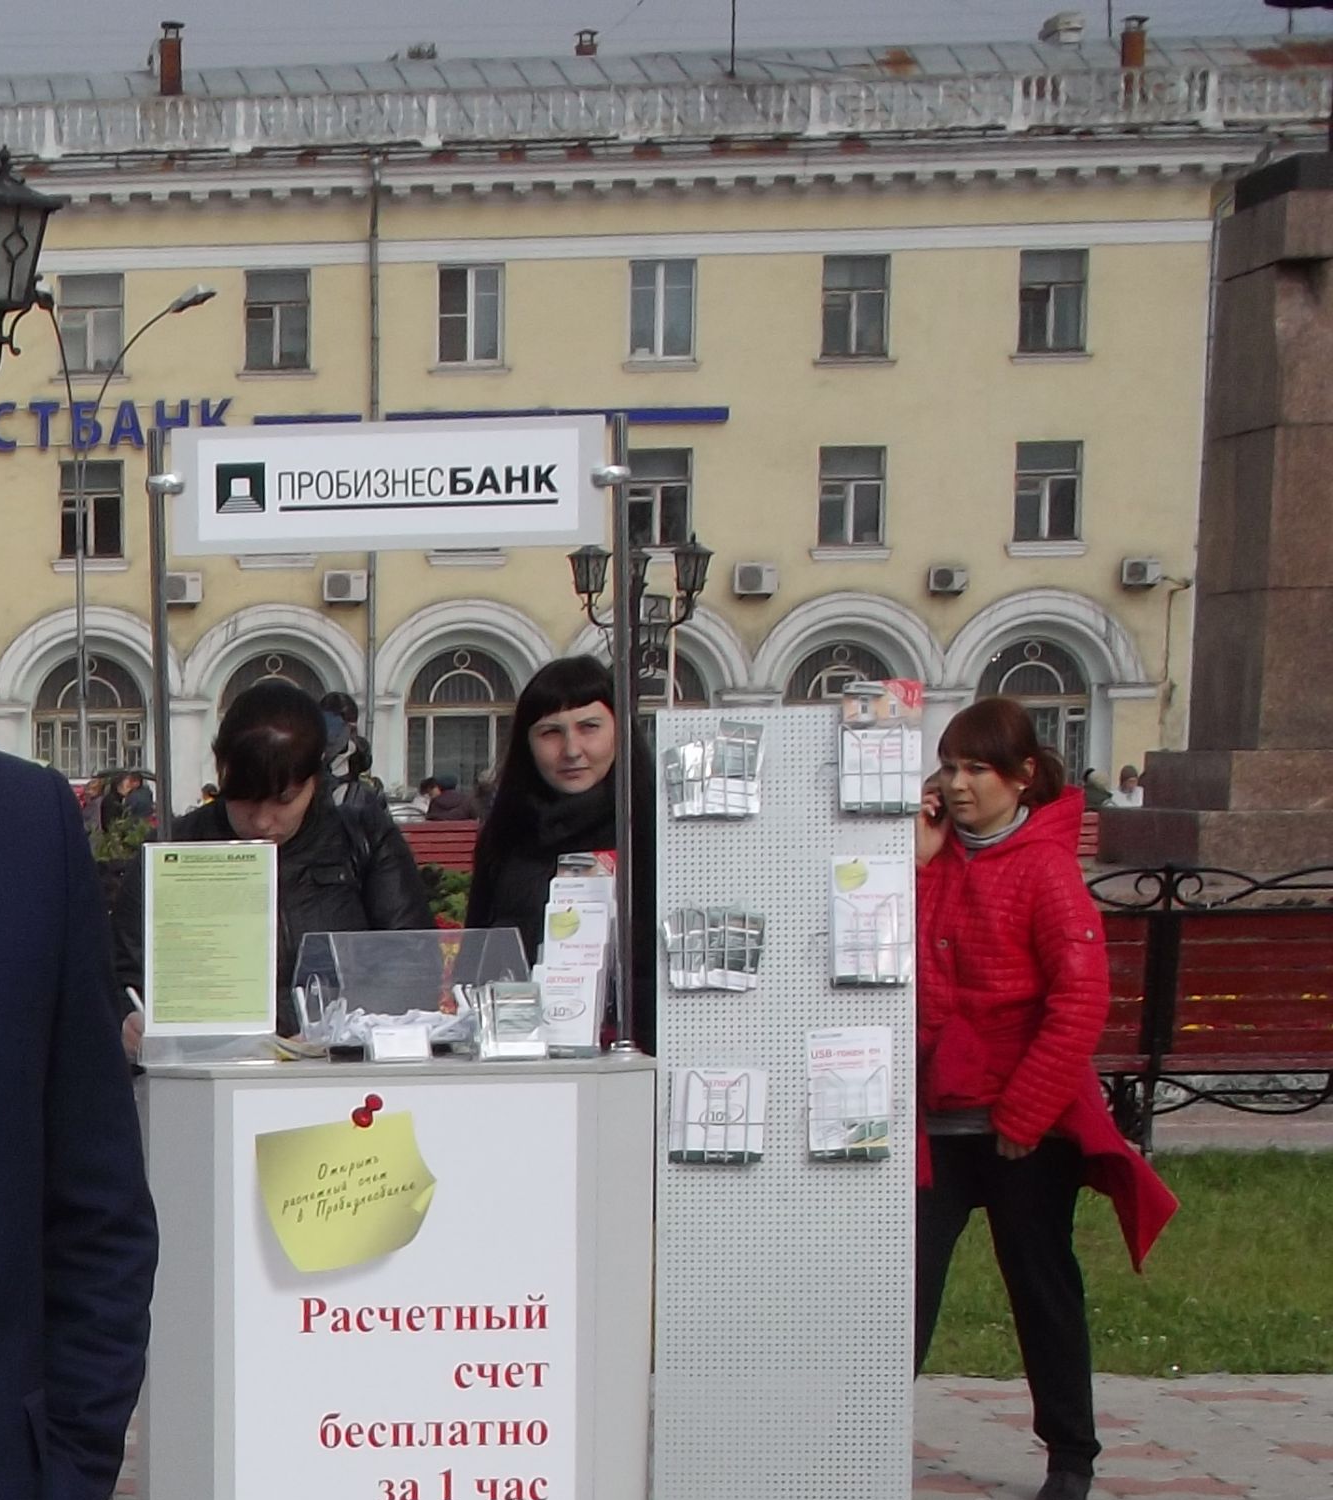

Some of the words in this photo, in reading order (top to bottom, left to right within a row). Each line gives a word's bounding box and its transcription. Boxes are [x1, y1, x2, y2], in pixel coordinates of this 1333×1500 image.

[277, 463, 559, 502] ПРОБИЗНЕСБАНК
[317, 1155, 380, 1180] Открыть
[281, 1181, 348, 1216] расчетный
[358, 1171, 388, 1187] счет
[298, 1293, 549, 1334] Расчетный
[453, 1361, 550, 1389] счет
[319, 1412, 549, 1448] бесплатно
